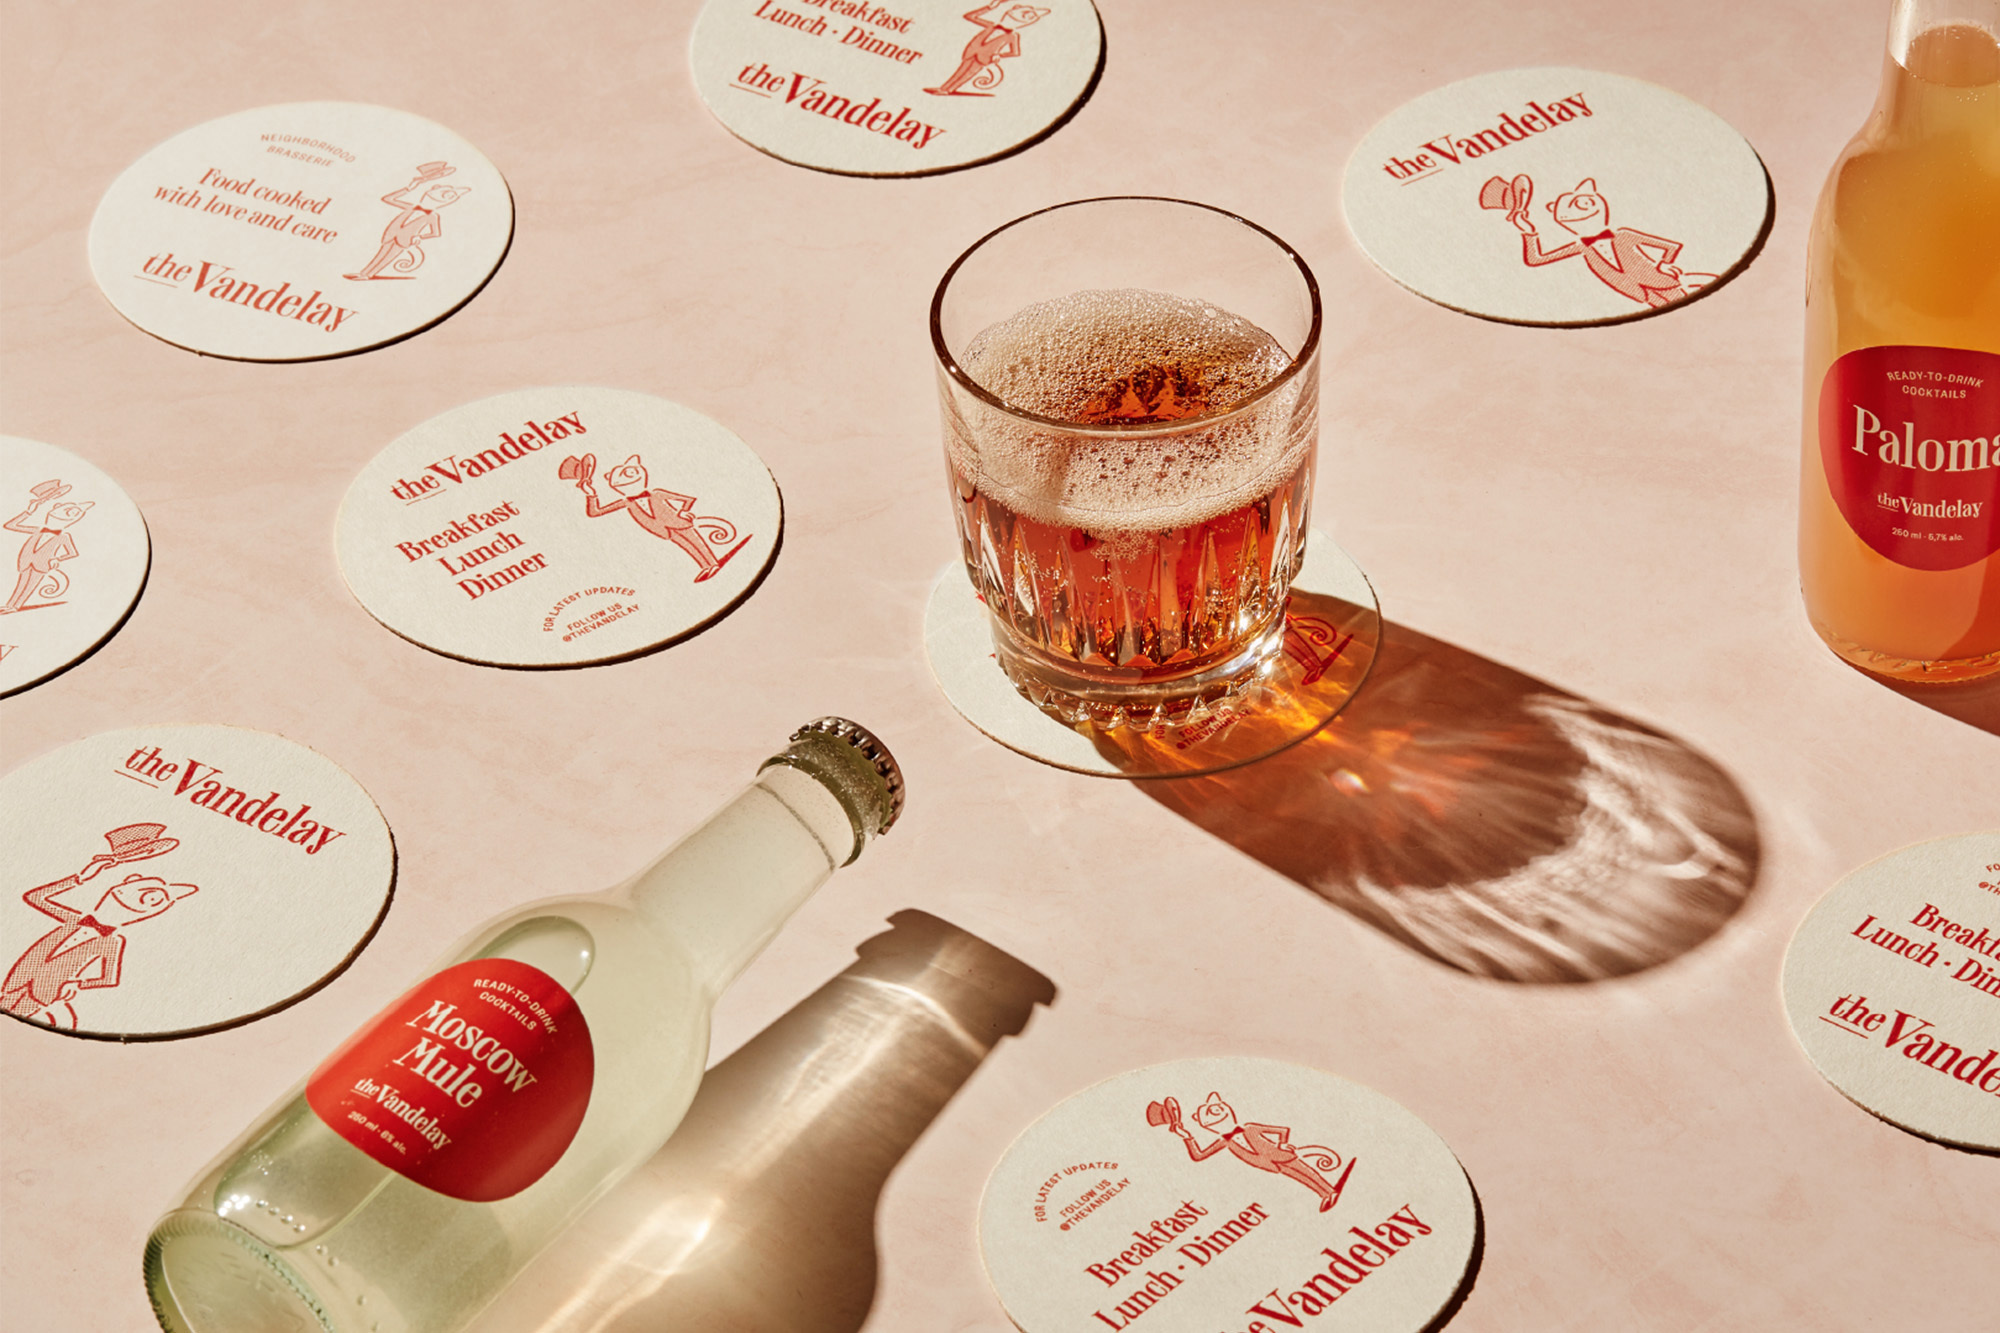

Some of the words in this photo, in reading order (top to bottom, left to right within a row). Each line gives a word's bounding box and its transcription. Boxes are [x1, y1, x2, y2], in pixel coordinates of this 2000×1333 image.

[753, 0, 828, 37] Lunch
[839, 26, 923, 65] Dinner
[802, 0, 915, 34] reakfast
[261, 133, 356, 163] NEIGHBORHOOD
[266, 145, 334, 167] BRASSERIE
[198, 167, 257, 197] Food
[252, 182, 332, 216] cooked
[154, 186, 202, 211] with
[199, 195, 246, 223] love
[247, 208, 294, 234] and
[290, 222, 338, 245] care
[1886, 371, 1984, 388] READY-TO-DRINK
[1902, 385, 1967, 399] COCKTAILS
[394, 499, 521, 563] Breakfast
[1910, 531, 1922, 539] ml
[436, 530, 526, 577] Lunch
[456, 551, 549, 601] Dinner
[584, 586, 635, 597] UPDATES
[549, 592, 581, 616] LATEST
[562, 603, 639, 643] @THEVANDELAY
[566, 609, 606, 632] FOLLOW
[606, 602, 622, 613] US
[543, 616, 556, 632] FOR
[1178, 715, 1217, 738] FOLLOW
[1850, 914, 1940, 968] Lunch
[473, 979, 558, 1035] READY-TO-DRINK
[479, 991, 537, 1032] COCKTAILS
[405, 999, 538, 1093] Moscow
[392, 1037, 483, 1109] Mule
[1035, 1172, 1062, 1203] LATEST
[1062, 1161, 1119, 1176] UPDATES
[1034, 1205, 1048, 1222] FOR
[1059, 1189, 1097, 1218] FOLLOW
[1095, 1179, 1111, 1191] US
[1059, 1177, 1131, 1231] @THEVANDELAY
[1083, 1200, 1209, 1288] Breakfast
[1091, 1270, 1185, 1333] Lunch
[1176, 1202, 1270, 1268] Dinner
